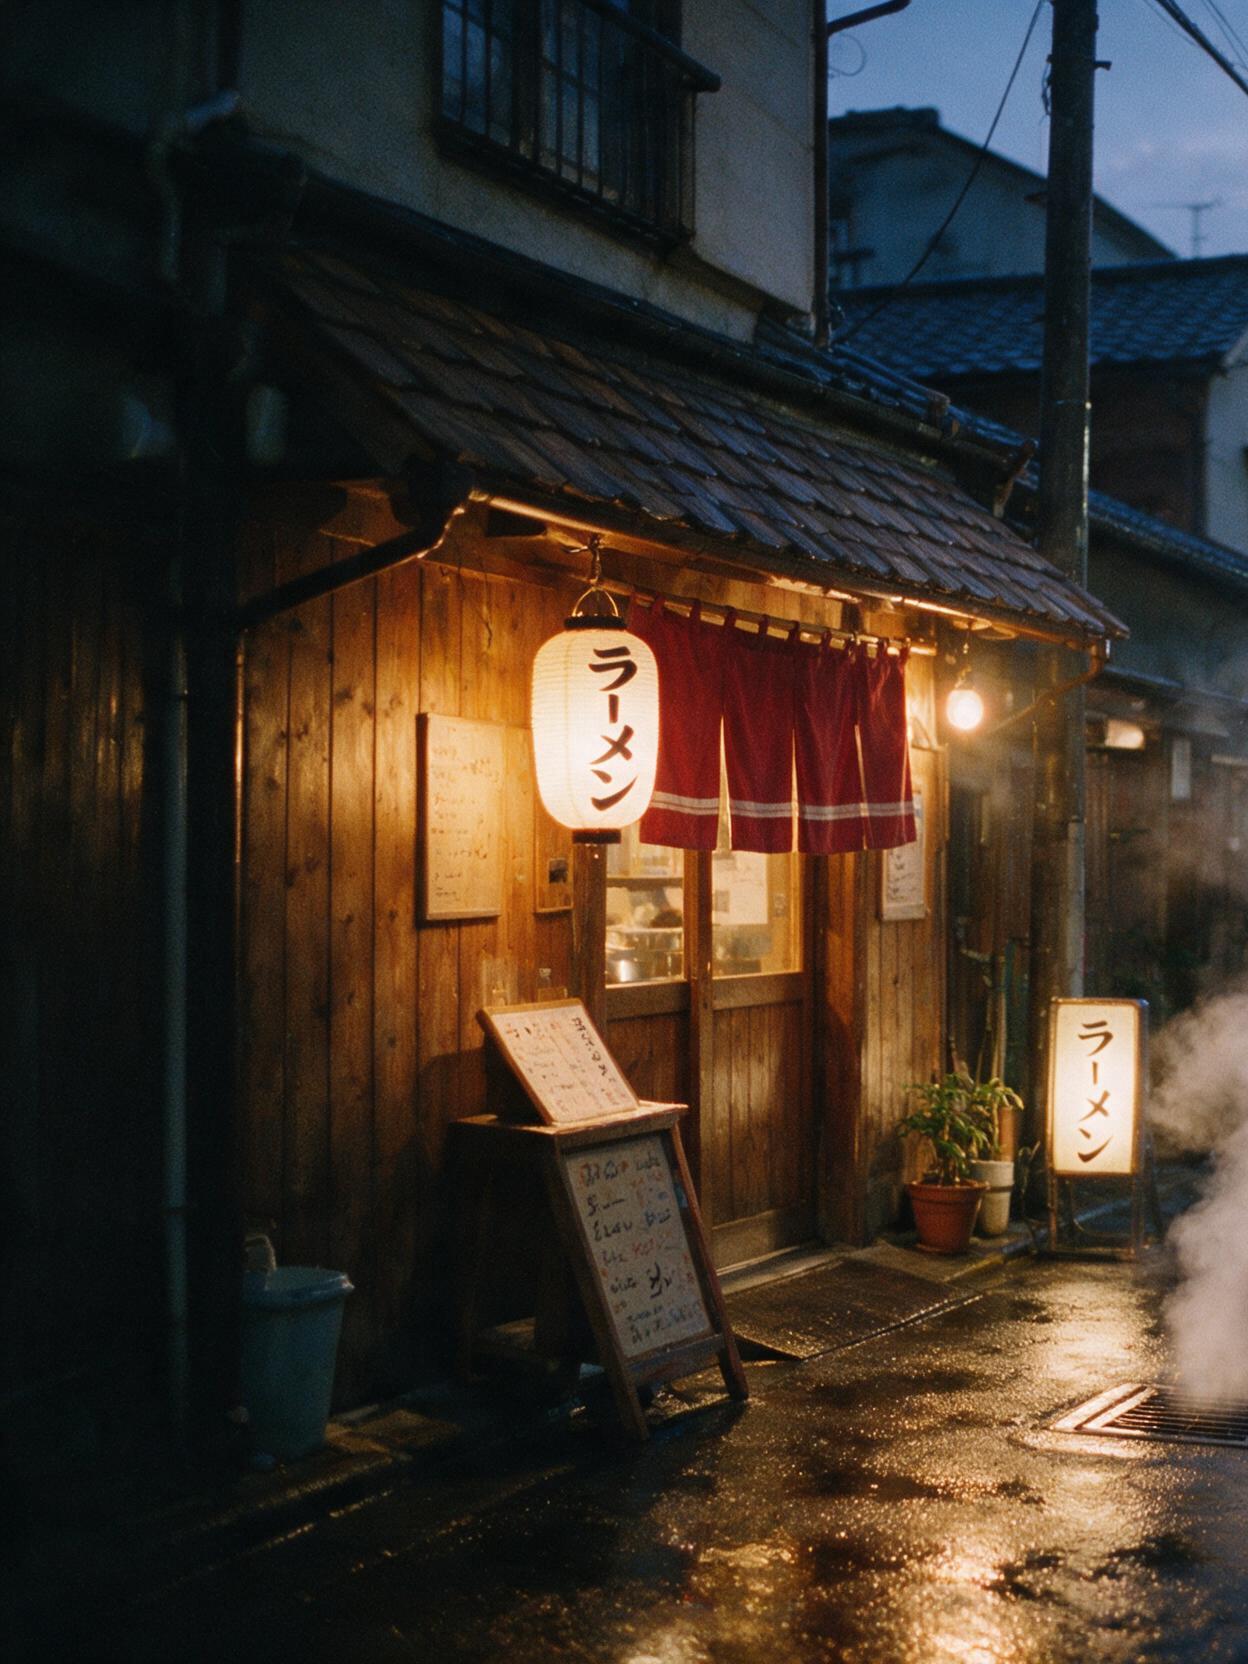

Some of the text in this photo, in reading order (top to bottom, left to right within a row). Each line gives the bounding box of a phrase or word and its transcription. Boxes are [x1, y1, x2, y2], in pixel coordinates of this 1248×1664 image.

[588, 646, 638, 811] ラーメン
[1077, 1020, 1114, 1163] ラーメン
